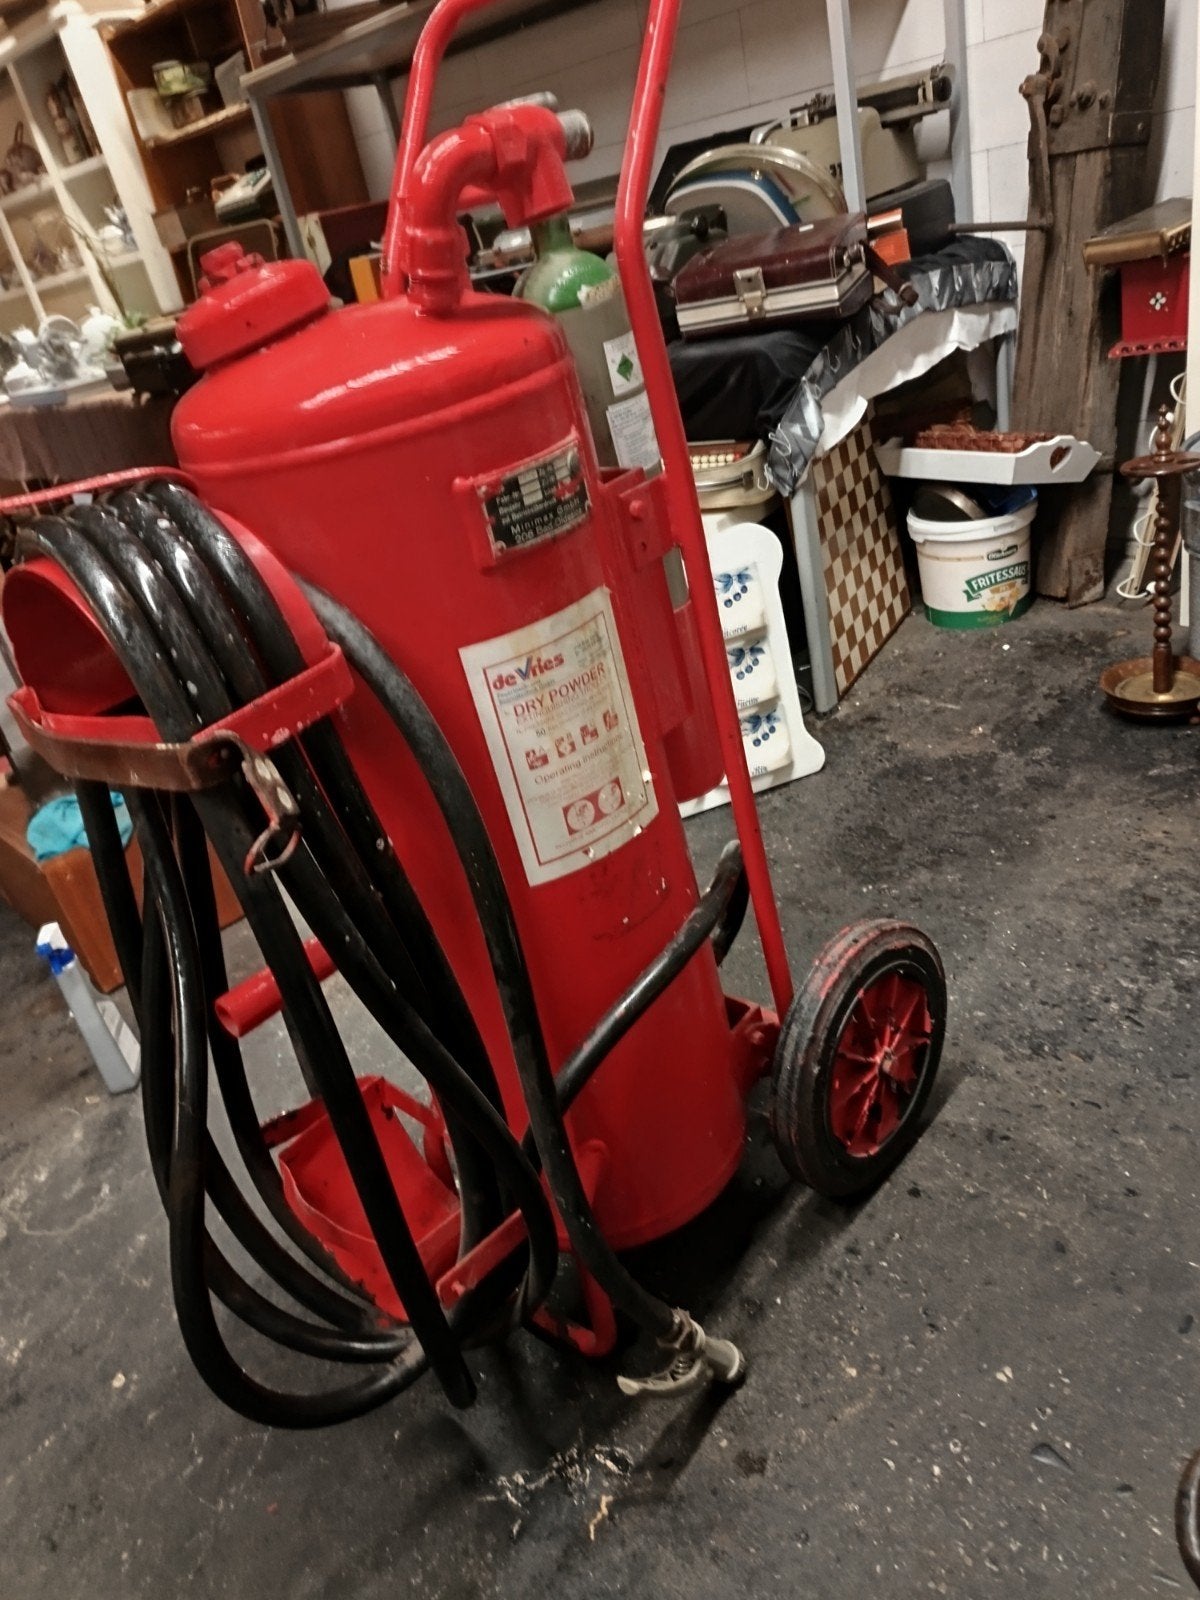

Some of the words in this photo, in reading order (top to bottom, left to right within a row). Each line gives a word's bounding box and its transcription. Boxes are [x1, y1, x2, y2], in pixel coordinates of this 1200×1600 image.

[511, 513, 553, 535] Minimax
[971, 564, 1026, 590] FRITESSAUS
[514, 694, 544, 717] DRY
[548, 662, 605, 703] POWDER
[534, 760, 581, 785] Operating
